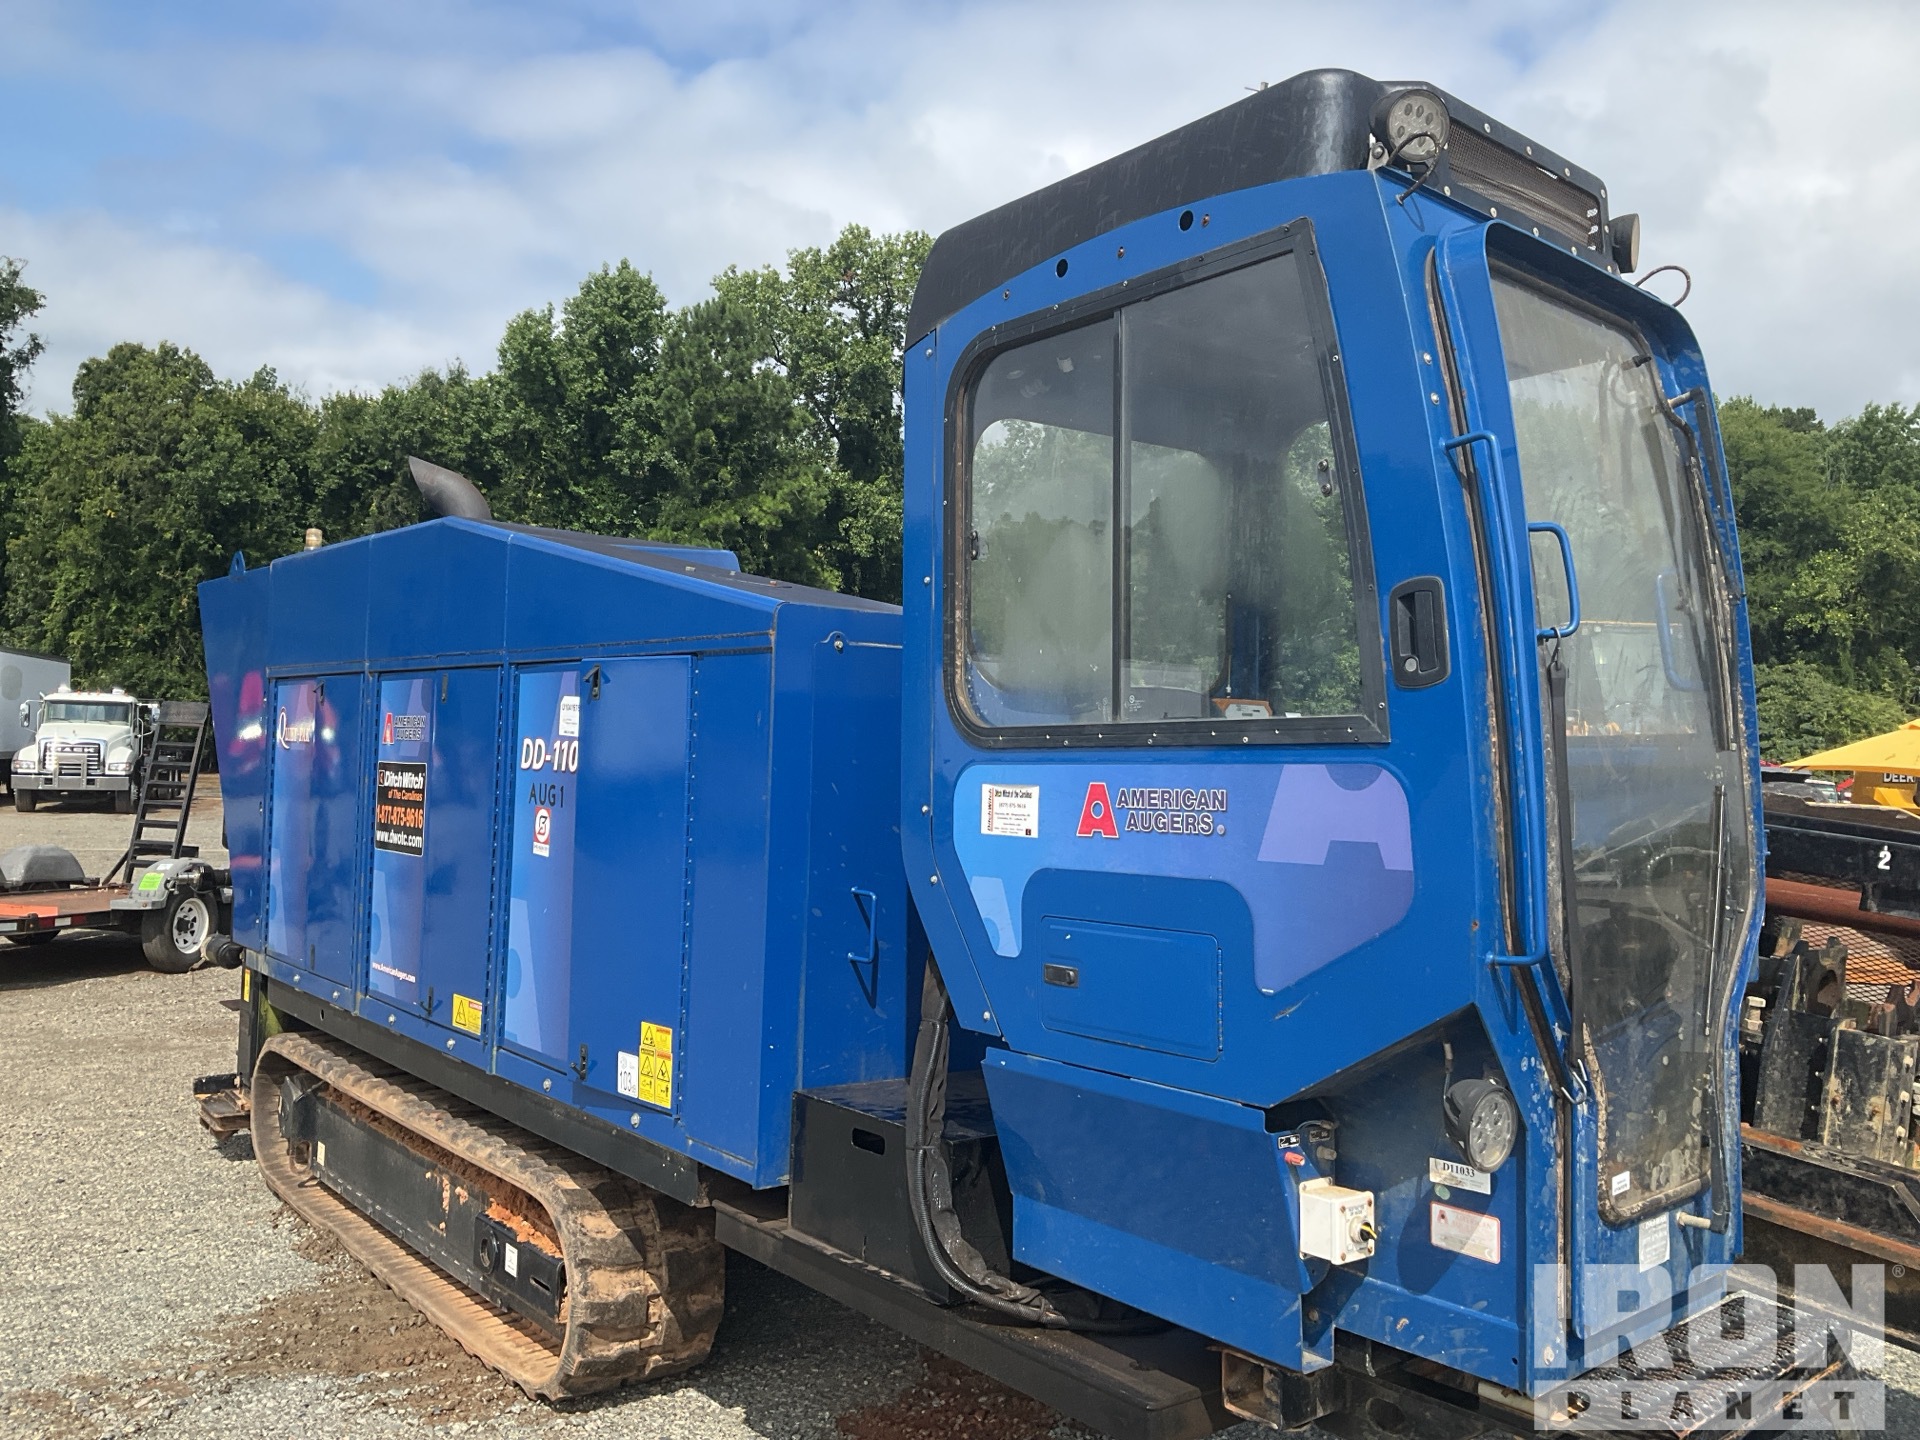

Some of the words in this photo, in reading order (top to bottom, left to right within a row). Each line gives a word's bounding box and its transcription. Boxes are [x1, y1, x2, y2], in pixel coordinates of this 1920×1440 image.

[394, 715, 426, 727] AMERICAN
[396, 728, 421, 740] AUGERS
[520, 738, 579, 772] DD-110
[384, 771, 402, 786] Ditch
[403, 772, 423, 789] Witch
[393, 789, 401, 799] The
[402, 790, 423, 801] Carolinas
[1116, 788, 1227, 811] AMERICAN
[376, 804, 423, 829] 1-877-875-9616
[1125, 811, 1214, 835] AUGERS
[1877, 851, 1892, 870] 2
[1442, 1161, 1475, 1177] D11033
